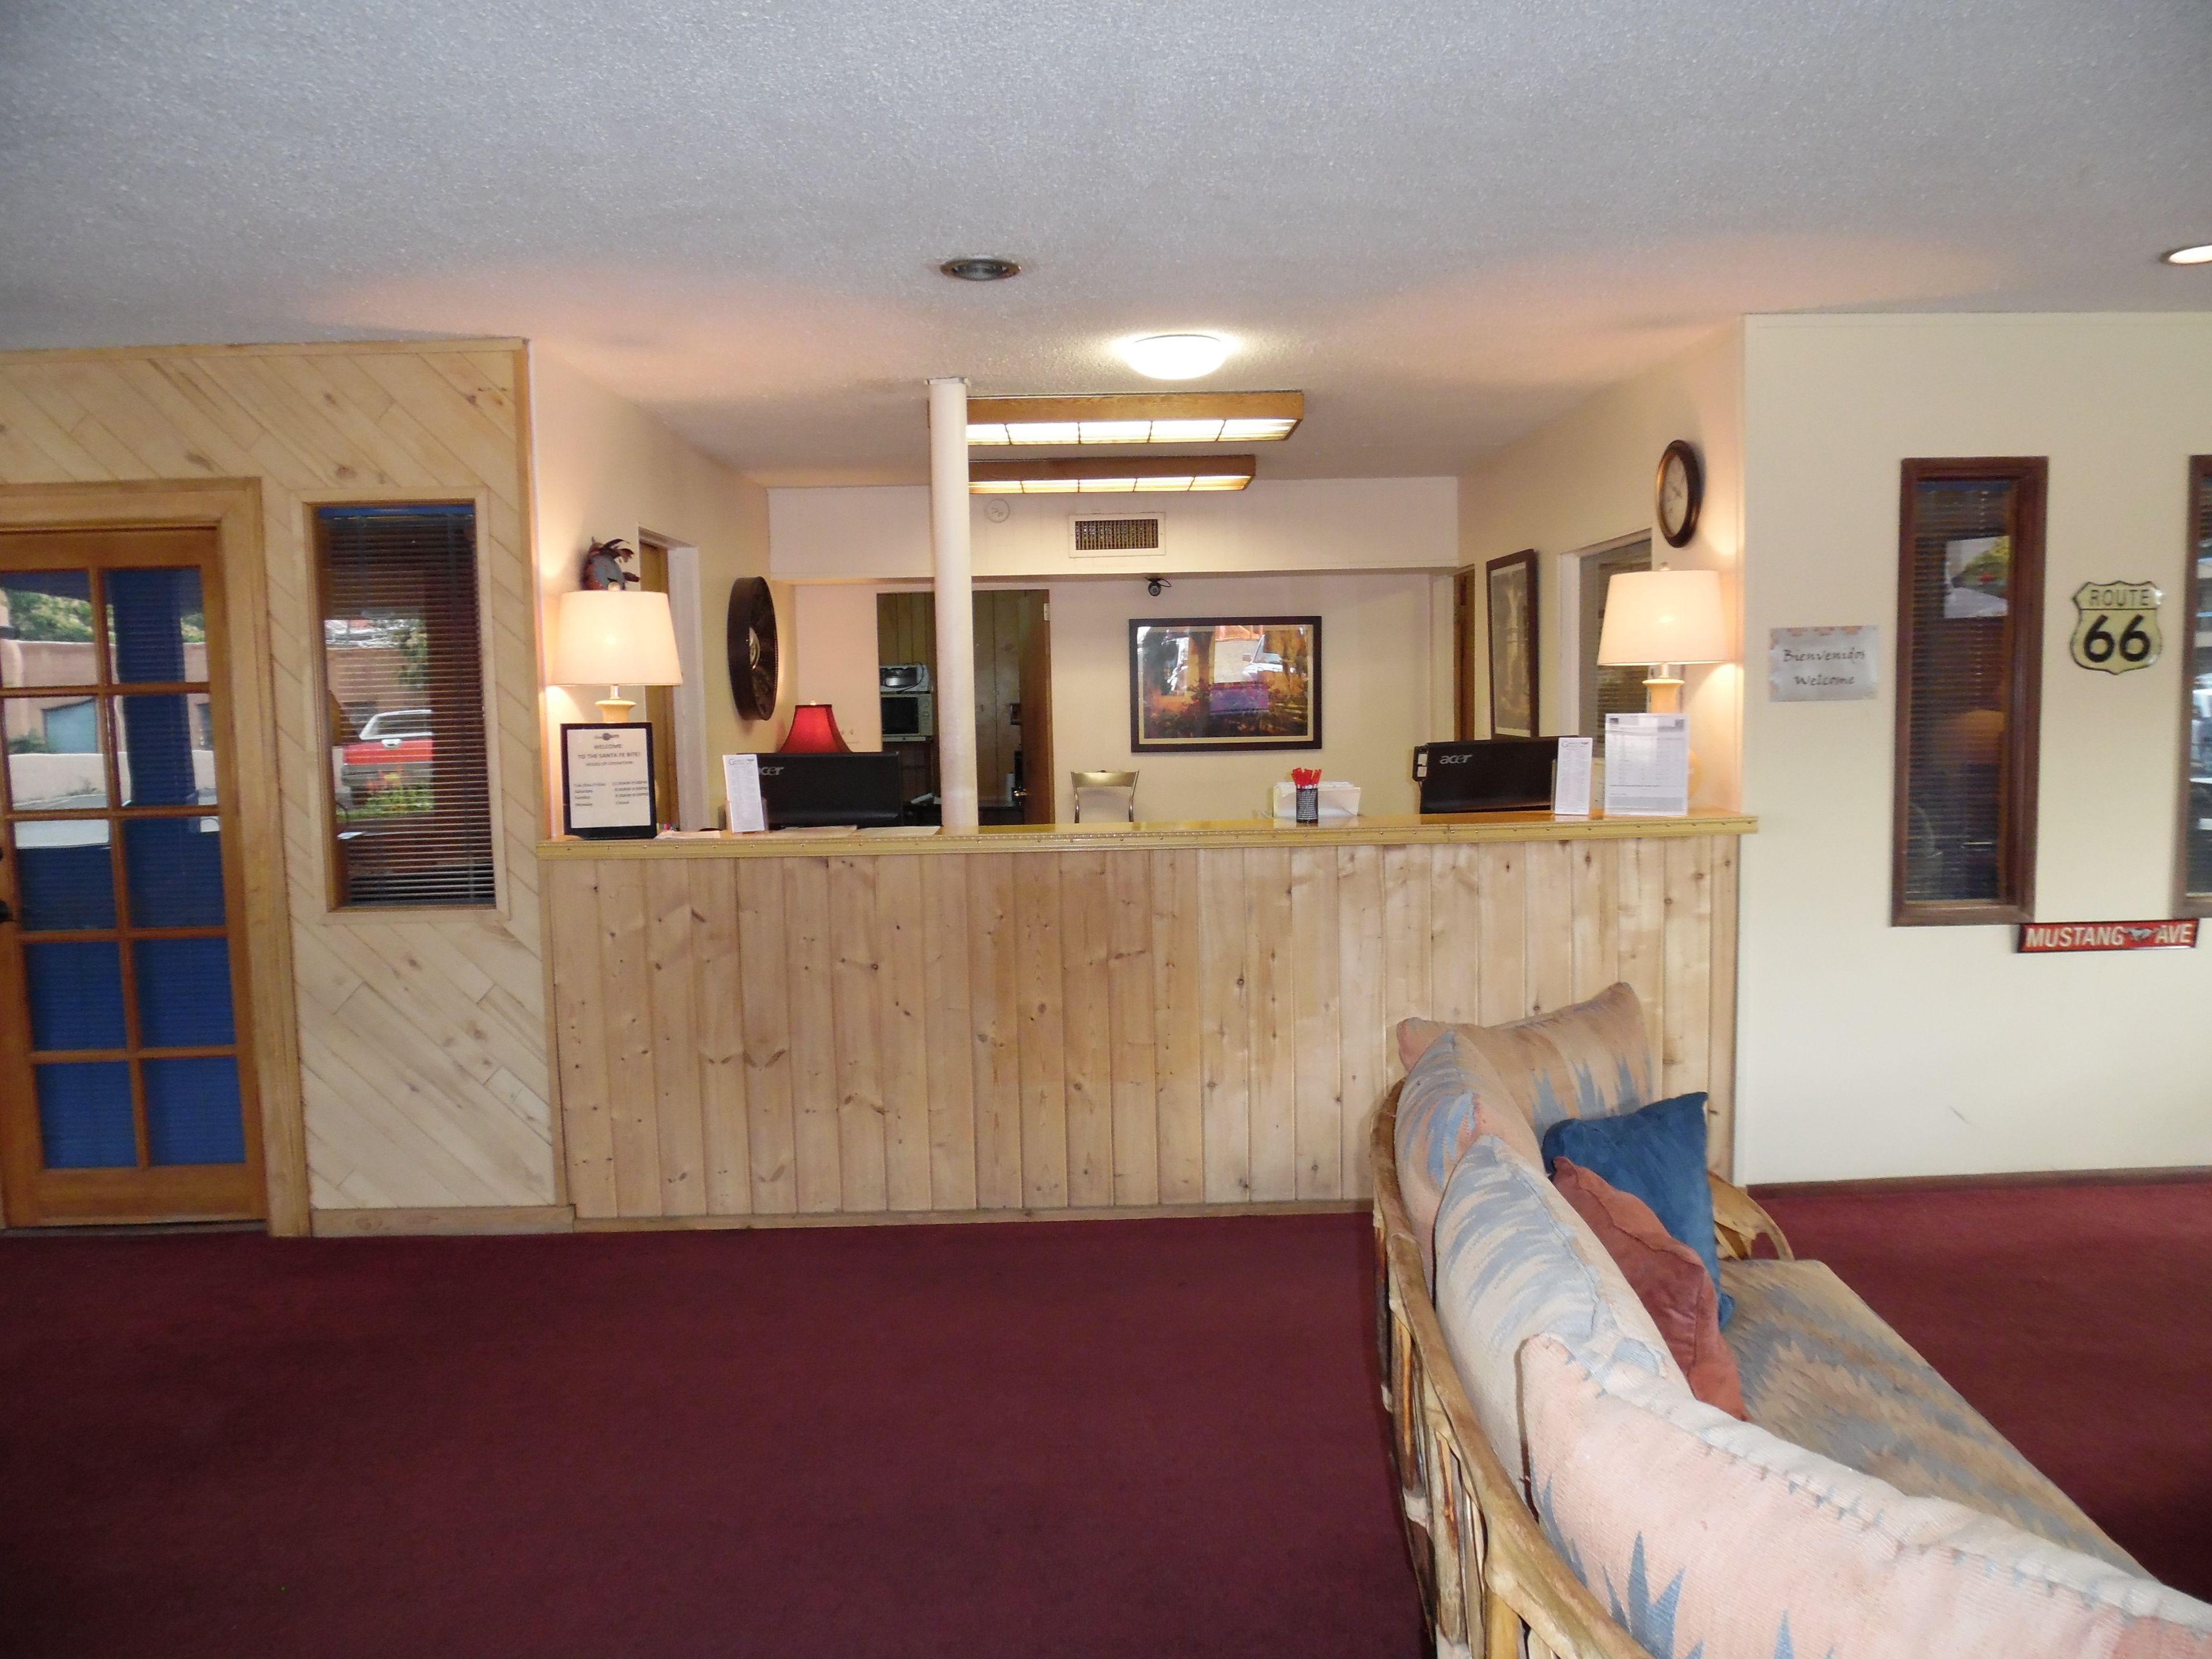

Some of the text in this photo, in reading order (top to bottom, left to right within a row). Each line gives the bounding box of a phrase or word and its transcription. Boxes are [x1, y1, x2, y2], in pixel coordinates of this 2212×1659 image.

[2089, 589, 2150, 606] ROUTE
[2084, 613, 2151, 663] 66
[1794, 673, 1855, 685] Welcome
[1440, 755, 1472, 764] acer
[760, 767, 784, 775] cer
[2025, 923, 2193, 947] MUSTANG AVE
